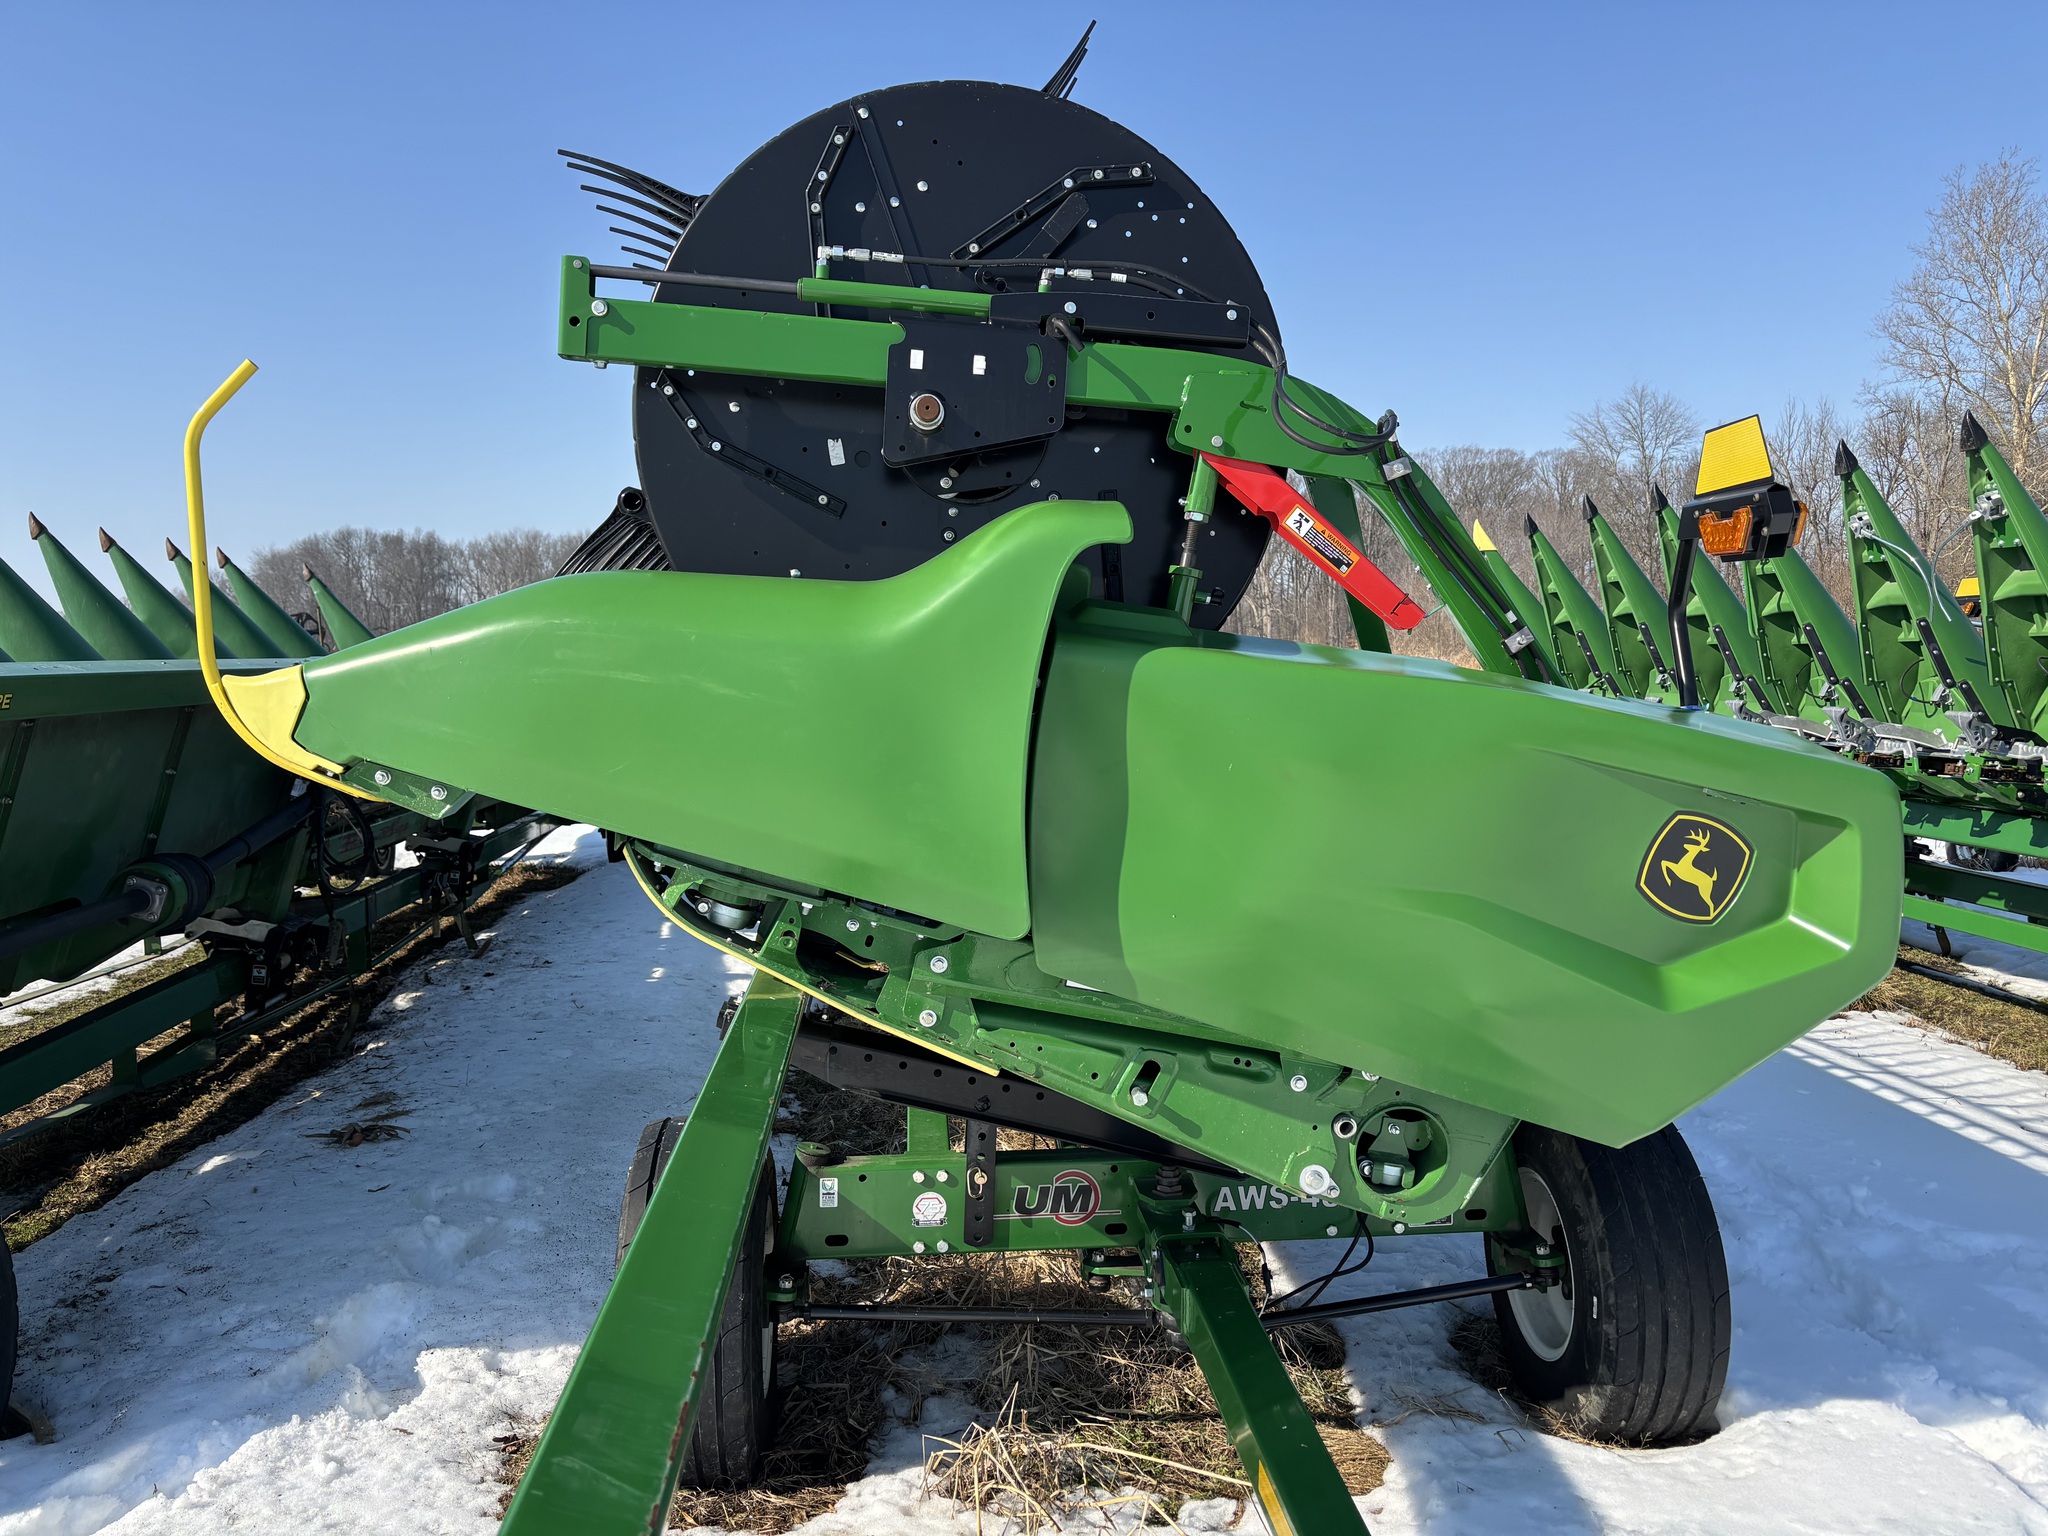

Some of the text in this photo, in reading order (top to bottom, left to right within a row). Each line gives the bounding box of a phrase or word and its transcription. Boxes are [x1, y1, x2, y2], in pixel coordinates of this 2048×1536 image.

[1327, 532, 1352, 556] WARNING
[1013, 1184, 1096, 1215] UM
[1213, 1185, 1339, 1213] AWS-4
